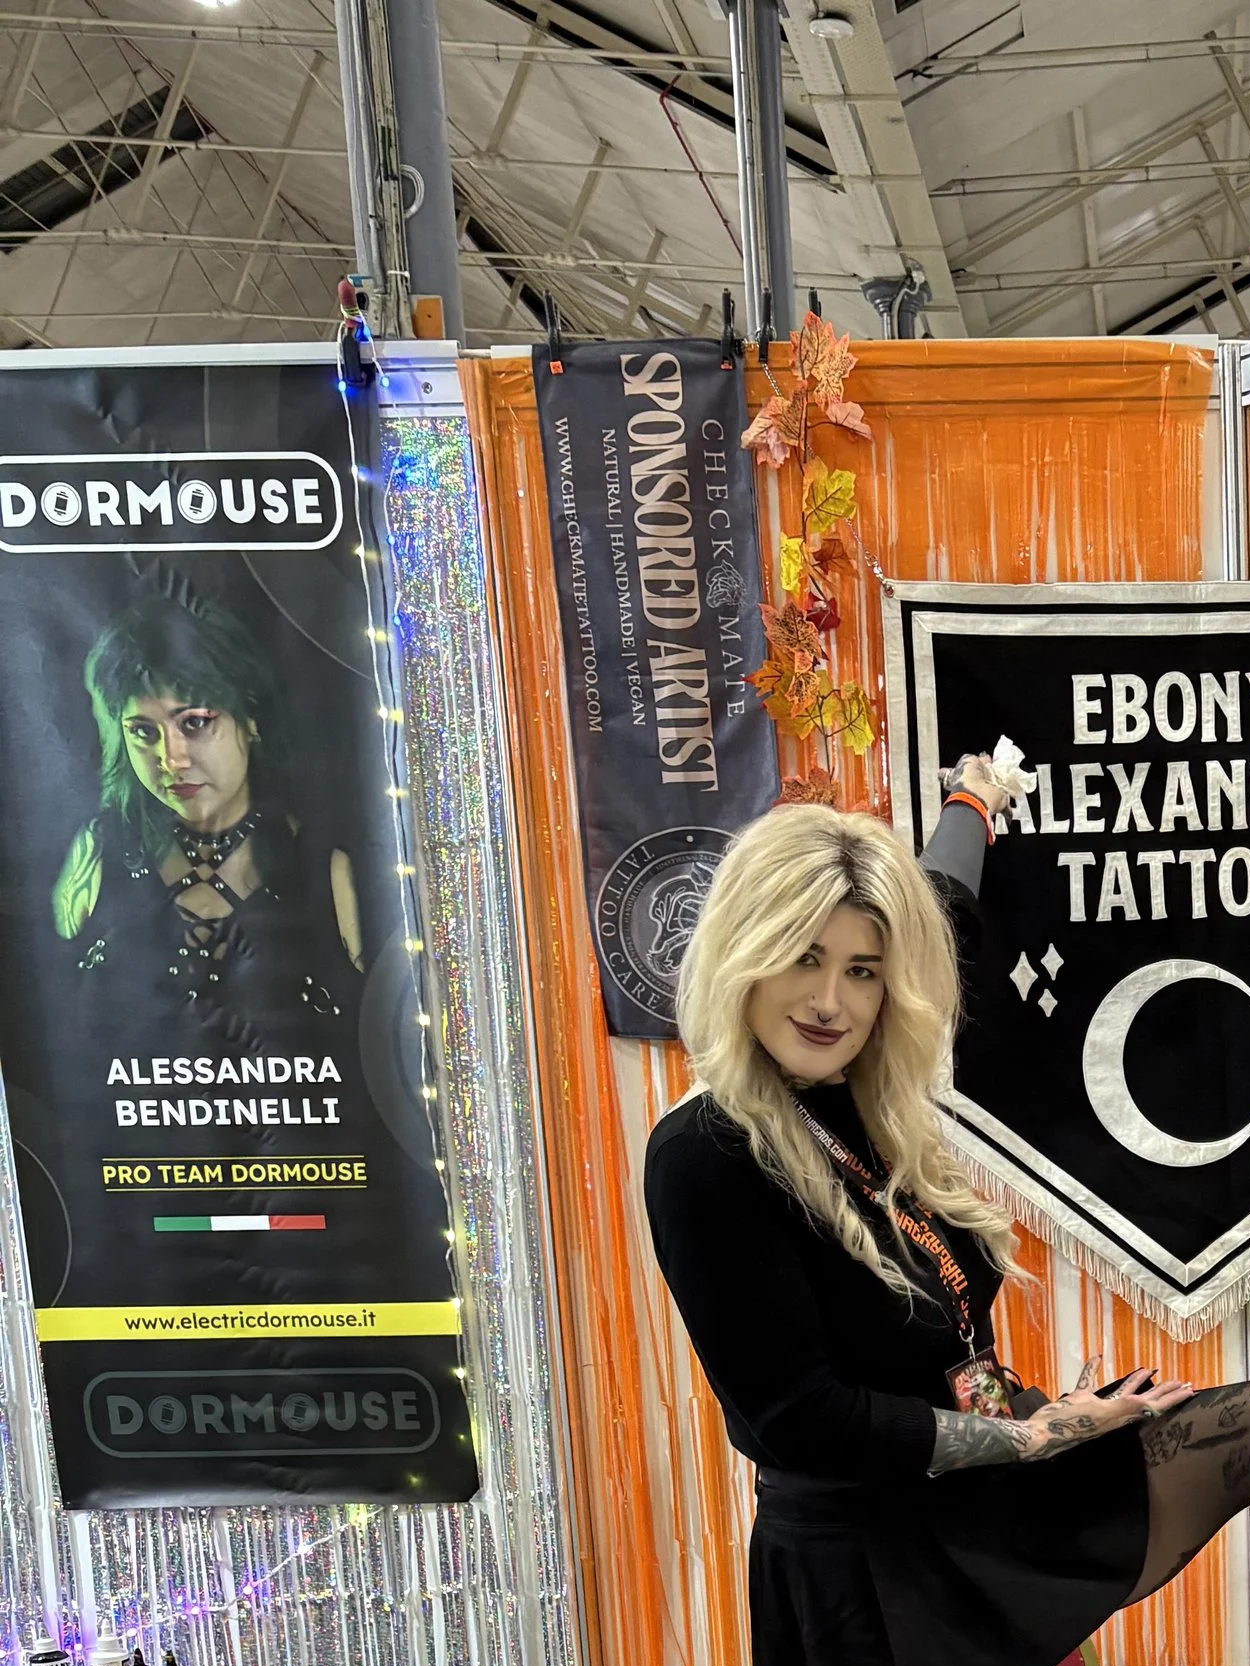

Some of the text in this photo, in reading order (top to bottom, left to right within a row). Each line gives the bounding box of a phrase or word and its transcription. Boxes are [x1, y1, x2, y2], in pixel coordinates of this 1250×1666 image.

[1, 477, 323, 528] DORMOUSE
[620, 352, 701, 630] SPONSORED
[553, 416, 603, 733] WWW.CHECKMATETATTOO.COM
[602, 429, 646, 726] NATURAL HANDMADE VEGAN
[701, 418, 747, 718] CHECK MATE
[646, 637, 718, 793] ARTIST
[602, 845, 656, 936] TATTOO
[608, 951, 661, 1010] CARE
[107, 1056, 342, 1086] ALESSANDRA
[115, 1097, 340, 1127] BENDINELLI
[103, 1162, 367, 1184] PRO TEAM DORMOUSE
[124, 1308, 377, 1333] www.electricdormouse.it
[107, 1390, 422, 1436] DORMOUSE
